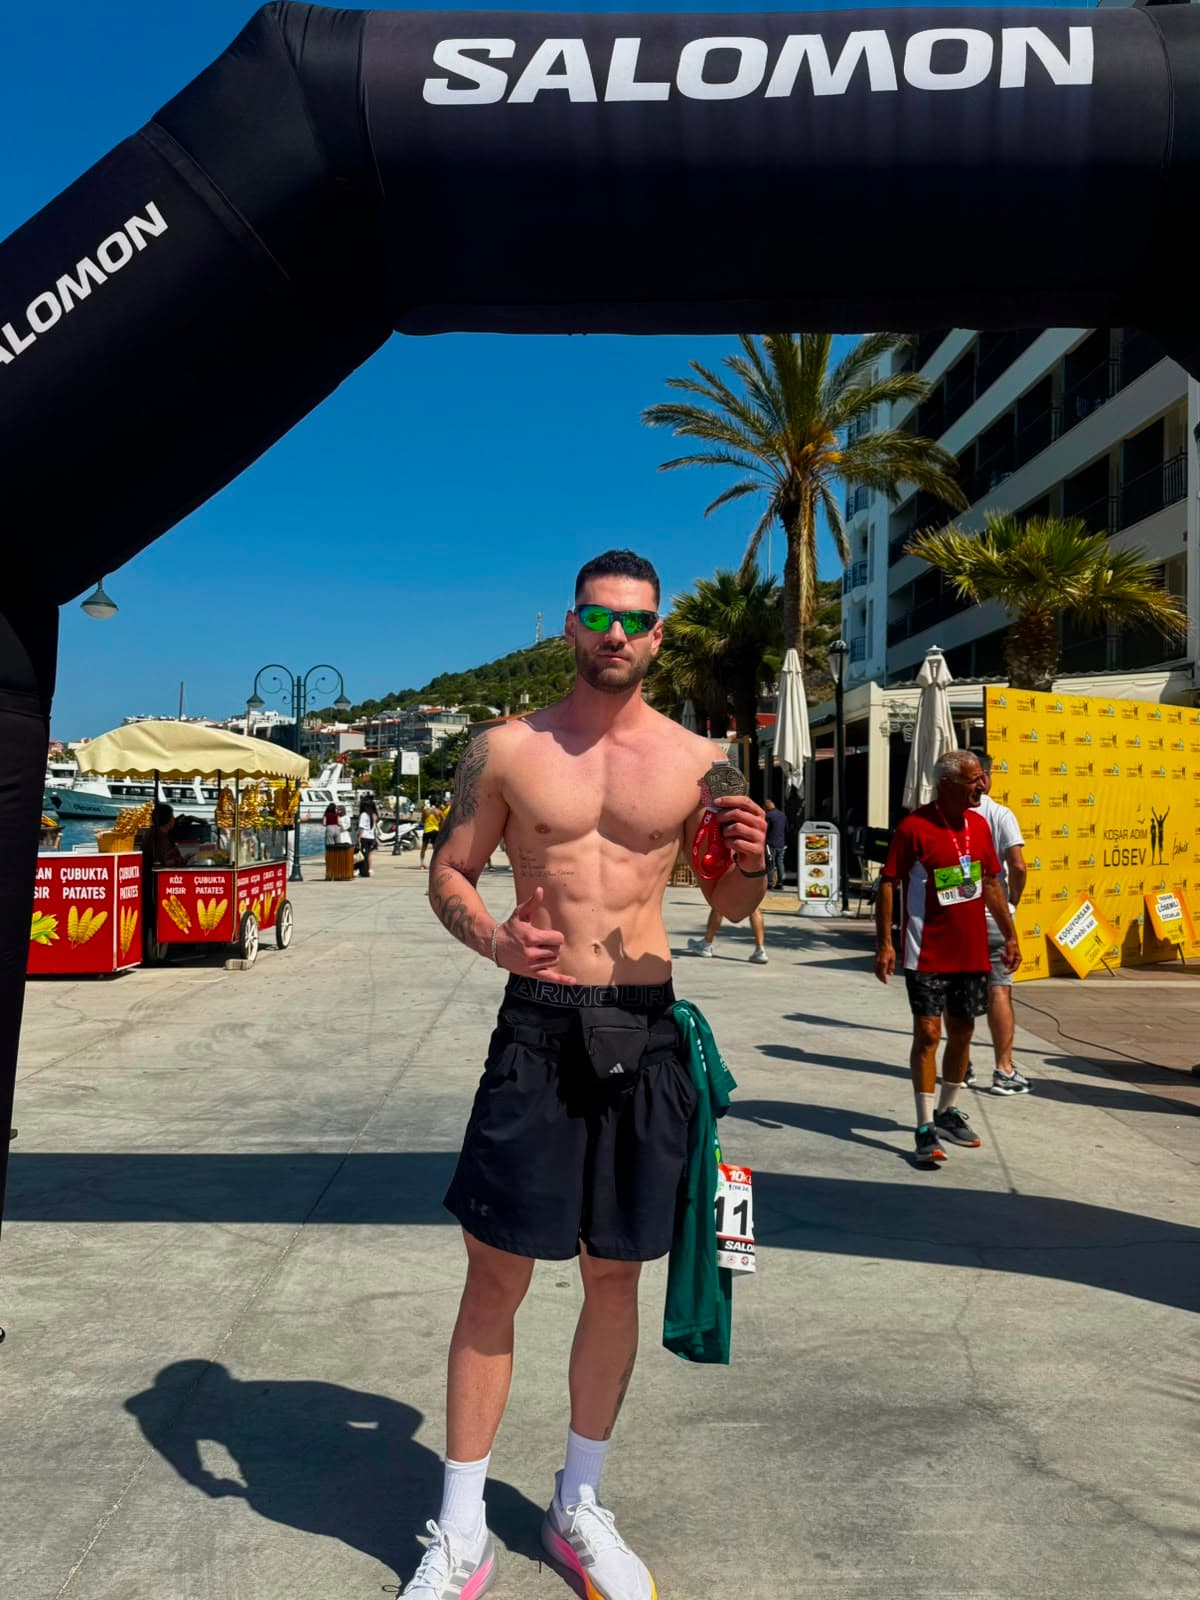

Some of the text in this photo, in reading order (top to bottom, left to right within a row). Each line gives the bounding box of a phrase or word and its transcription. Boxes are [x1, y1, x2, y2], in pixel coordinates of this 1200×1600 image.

[423, 26, 1094, 105] SALOMON
[1104, 828, 1148, 843] KOŞAR ADIM
[1103, 844, 1147, 867] LÖSEV
[60, 867, 109, 884] ÇUBUKTA
[169, 875, 183, 884] KÖZ
[194, 876, 225, 885] ÇUBUKTA
[62, 886, 107, 900] PATATES
[166, 887, 186, 895] MISIR
[195, 886, 224, 895] PATATES
[512, 977, 665, 1007] ARMOUR
